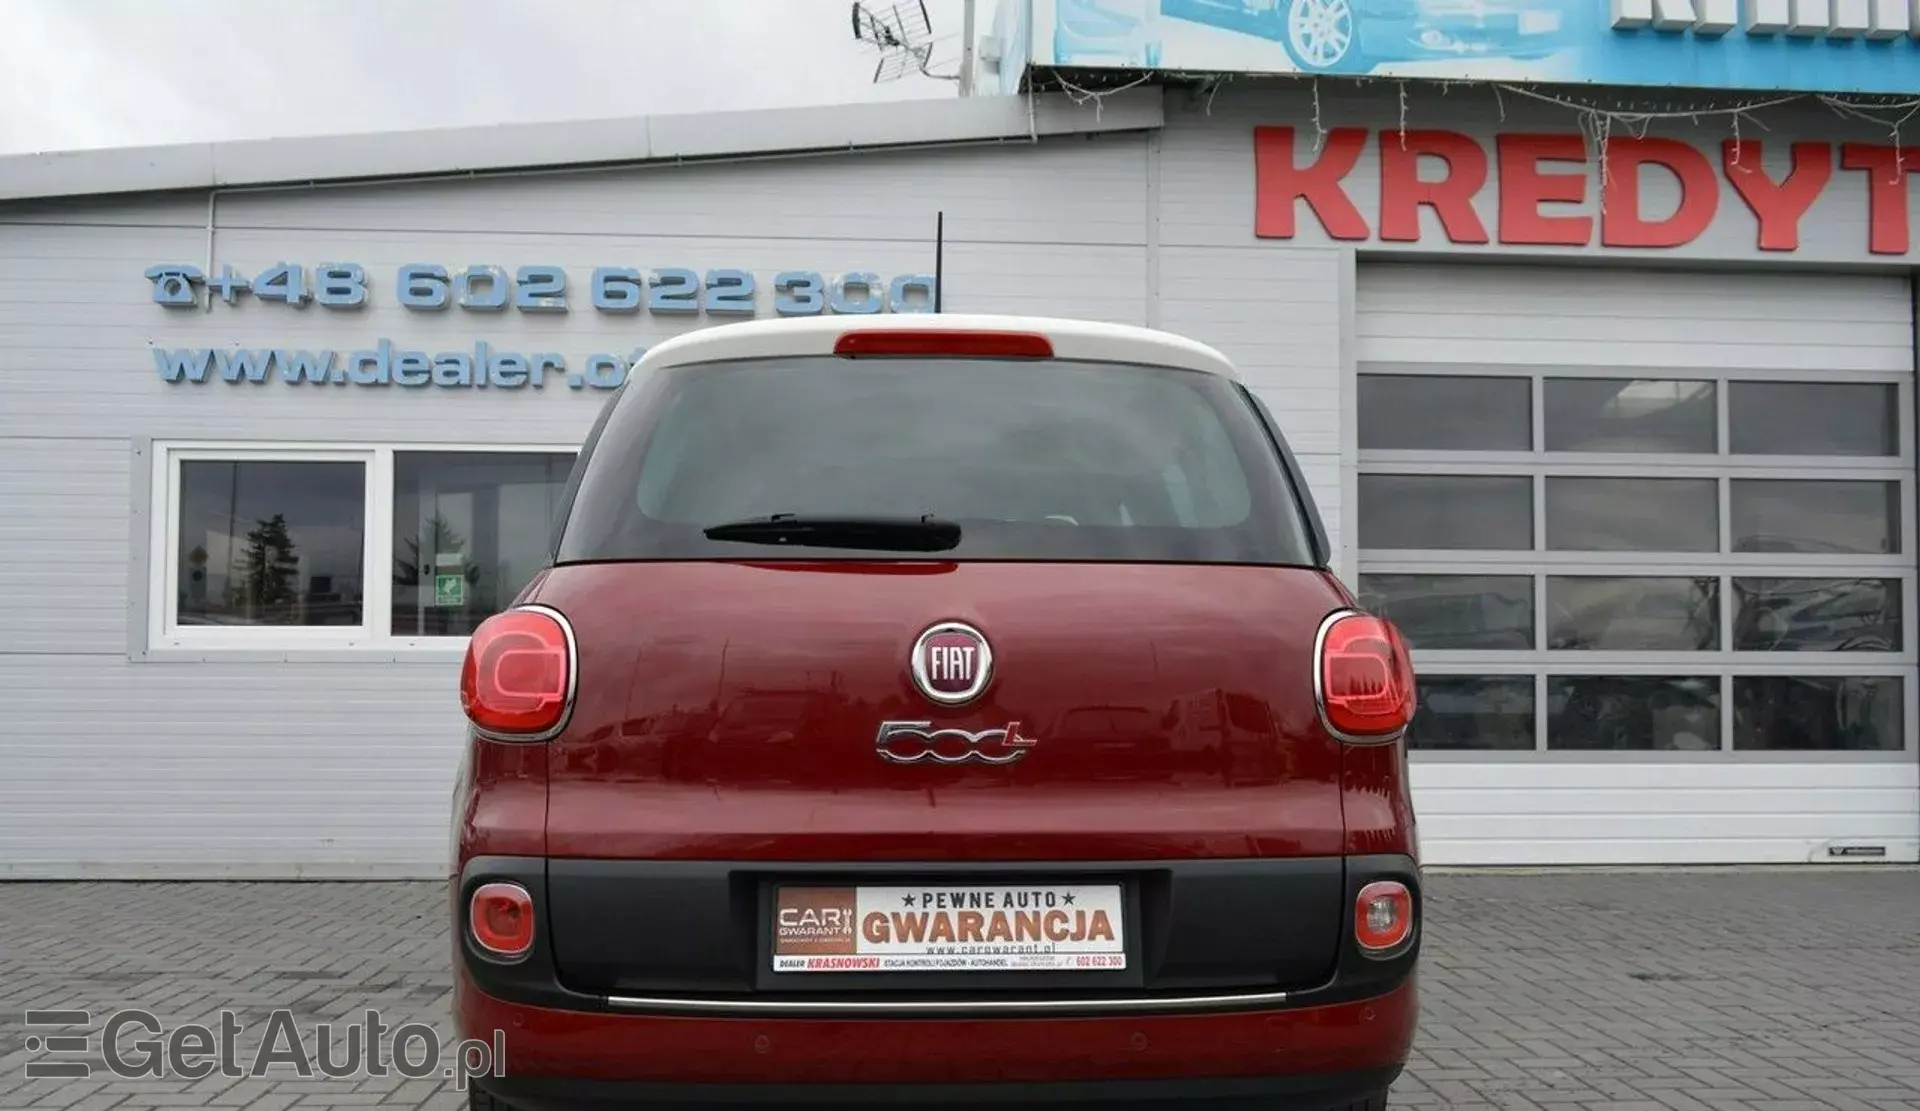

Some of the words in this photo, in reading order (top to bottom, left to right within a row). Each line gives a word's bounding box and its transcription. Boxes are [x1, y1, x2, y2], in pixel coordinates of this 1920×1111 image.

[1253, 125, 1920, 256] KREDYT
[206, 262, 367, 309] +48
[396, 264, 569, 313] 602
[591, 266, 756, 316] 622
[774, 270, 939, 316] 300
[152, 338, 648, 390] www.dealer.o
[931, 647, 975, 680] FIAT
[875, 720, 1038, 764] 500L
[921, 892, 996, 909] PEWNE
[1002, 890, 1057, 908] AUTO
[779, 908, 842, 927] CAR
[779, 926, 842, 936] GWARANT
[861, 909, 1116, 944] GWARANCJA
[779, 959, 805, 968] DEALER
[806, 957, 881, 969] KRASNOWSKI
[1075, 955, 1091, 967] 602
[1092, 955, 1107, 967] 622
[1108, 955, 1124, 967] 300
